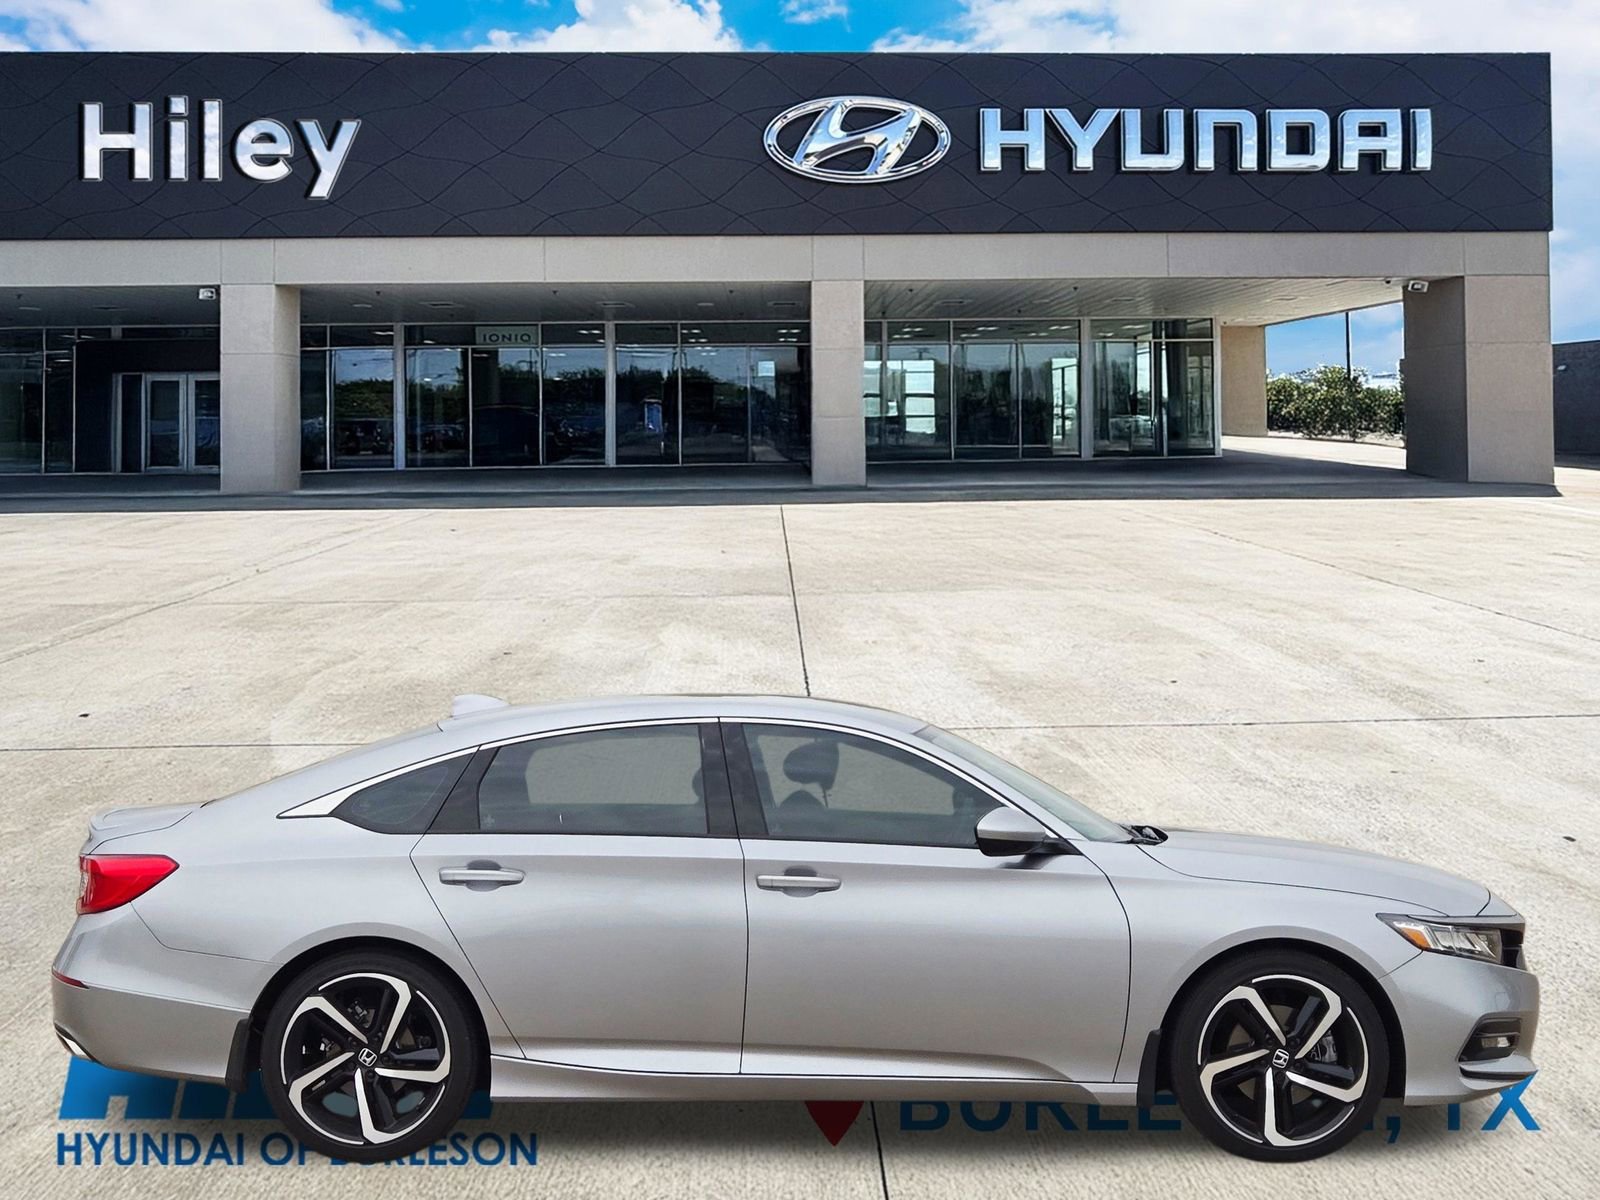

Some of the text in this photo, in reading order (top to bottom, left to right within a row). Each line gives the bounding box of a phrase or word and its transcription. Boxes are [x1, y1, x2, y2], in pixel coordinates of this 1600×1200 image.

[80, 95, 361, 199] Hiley
[979, 107, 1432, 172] HYUNDAI
[56, 1132, 245, 1166] HYUNDAI
